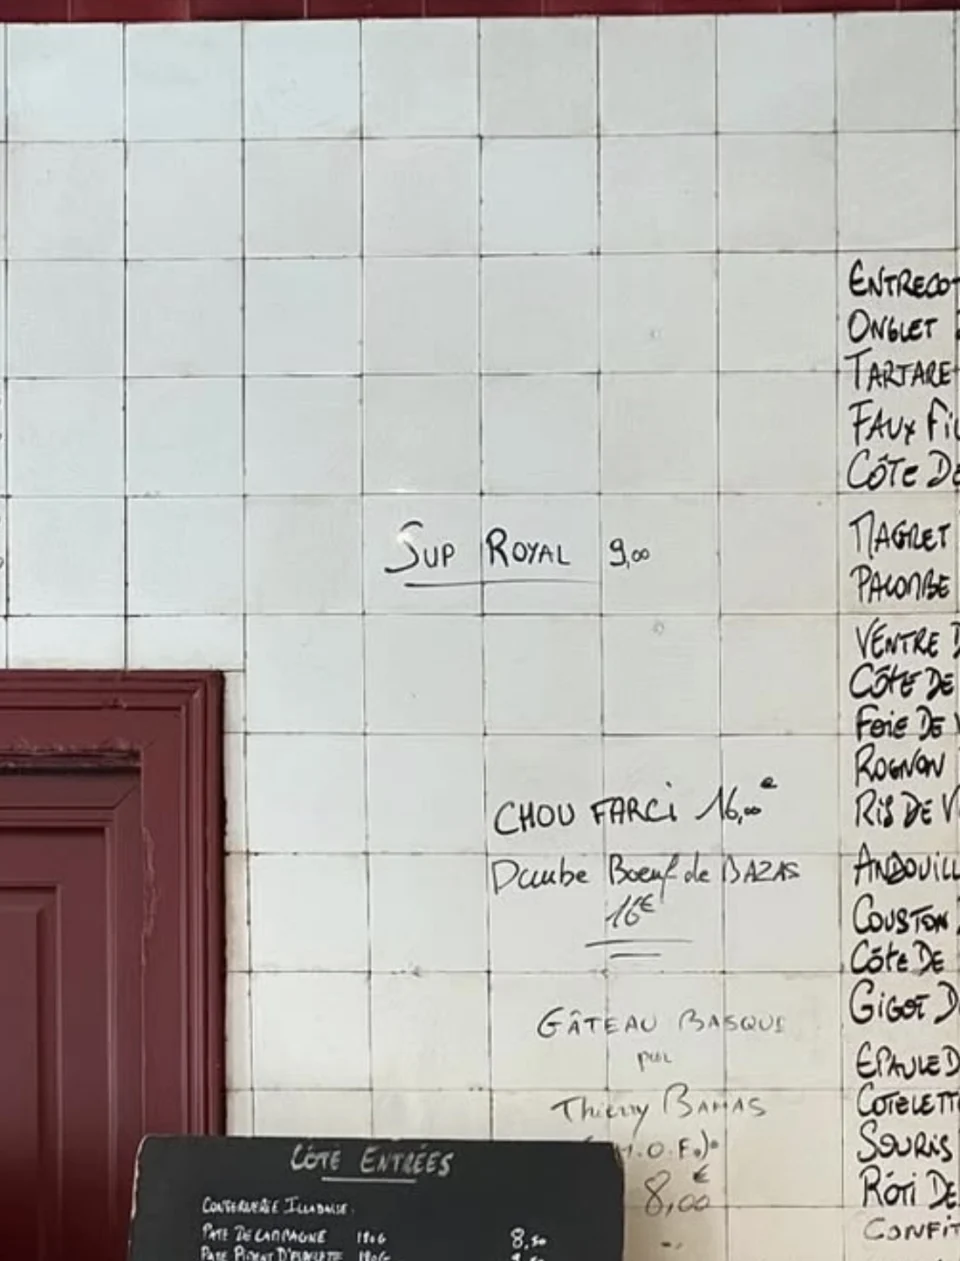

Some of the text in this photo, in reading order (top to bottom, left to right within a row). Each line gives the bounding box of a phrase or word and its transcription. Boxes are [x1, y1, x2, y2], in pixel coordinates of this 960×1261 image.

[847, 308, 939, 343] ONGLET
[843, 347, 952, 392] TARTARE
[848, 397, 918, 446] FAUX
[384, 520, 456, 574] SUP
[485, 527, 572, 568] ROYAL
[855, 616, 940, 658] VENTRE
[926, 664, 954, 699] DE
[916, 704, 946, 741] DE
[493, 800, 576, 835] CHOU
[901, 790, 932, 828] DE
[913, 940, 945, 976] DE
[536, 1006, 658, 1039] GÂTEAU
[926, 1169, 957, 1210] DE
